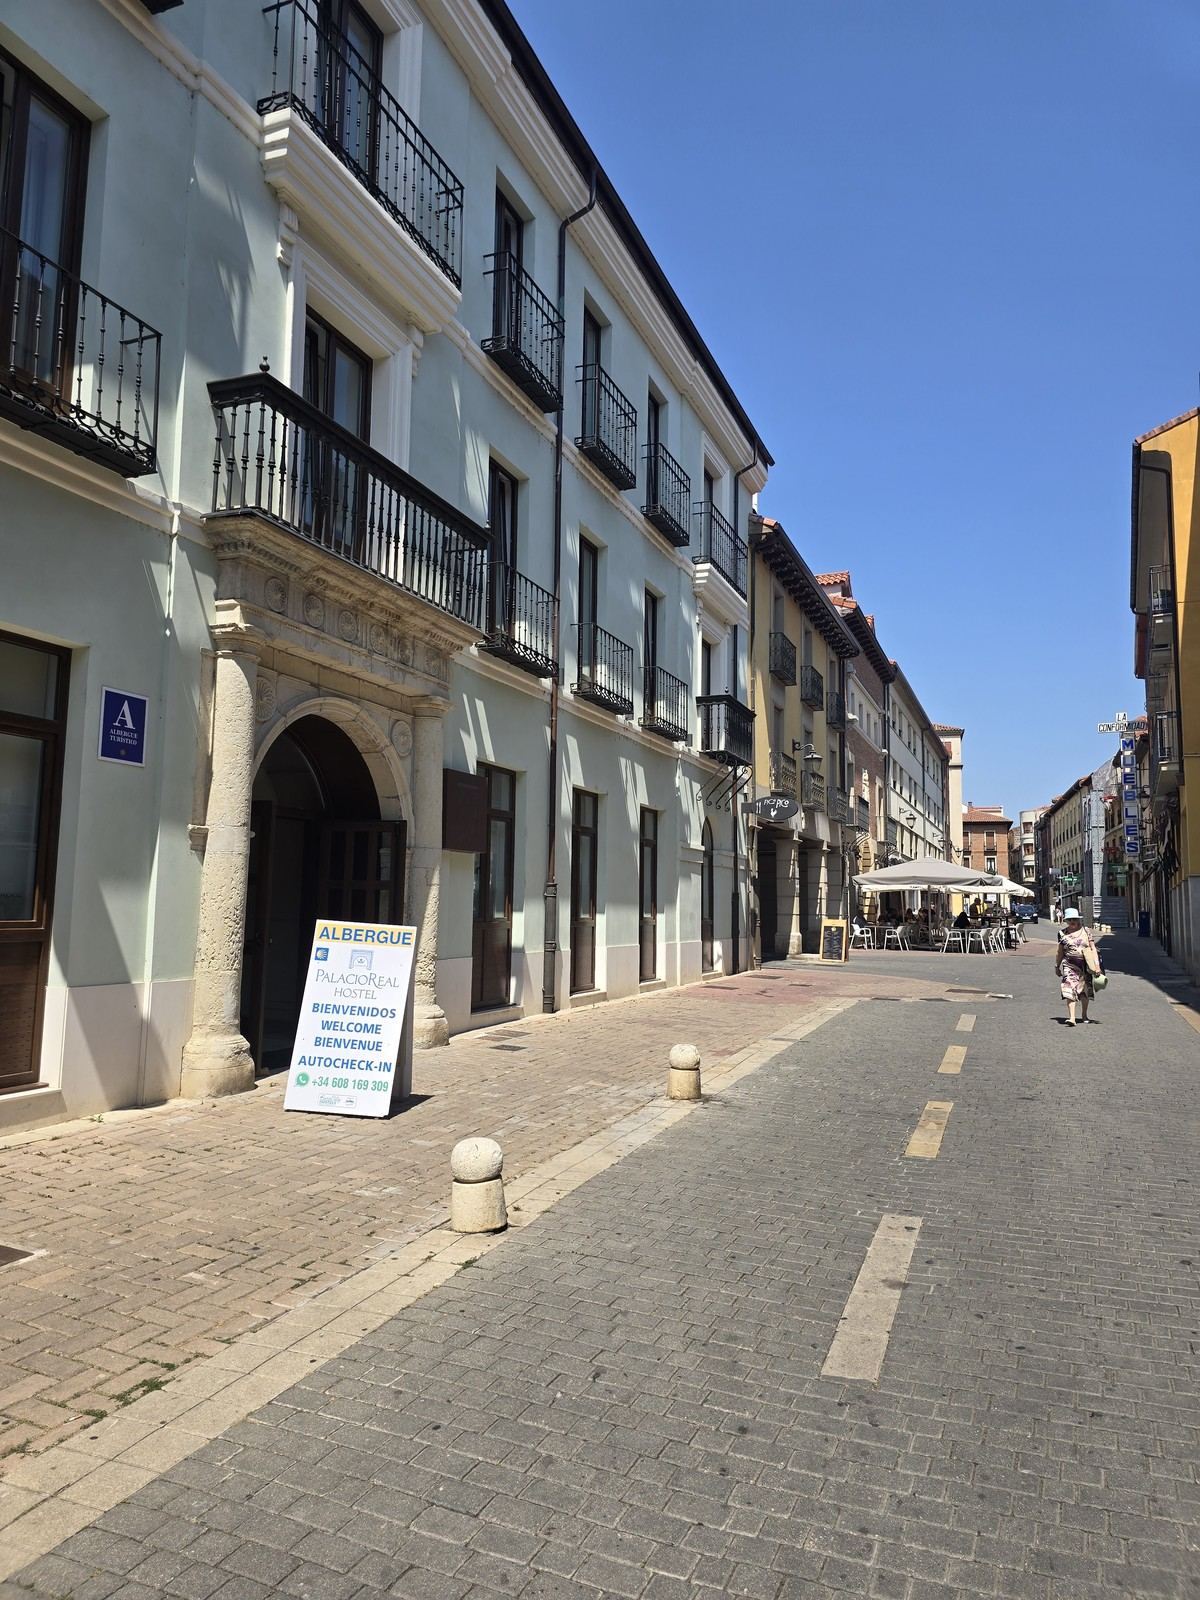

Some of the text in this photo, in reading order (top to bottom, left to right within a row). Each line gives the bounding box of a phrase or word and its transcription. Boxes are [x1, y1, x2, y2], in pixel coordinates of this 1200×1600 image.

[113, 699, 135, 729] A
[1117, 712, 1127, 722] LA
[110, 729, 137, 738] ALBERGUE
[1122, 740, 1139, 852] MUEBLES
[319, 926, 413, 945] ALBERGUE
[334, 987, 377, 1000] HOSTEL
[311, 1002, 396, 1019] BIENVENIDOS
[321, 1019, 382, 1035] WELCOME
[313, 1036, 383, 1052] BIENVENUE
[298, 1055, 392, 1072] AUTOCHECK-IN
[311, 1076, 389, 1092] +34 608 169 309
